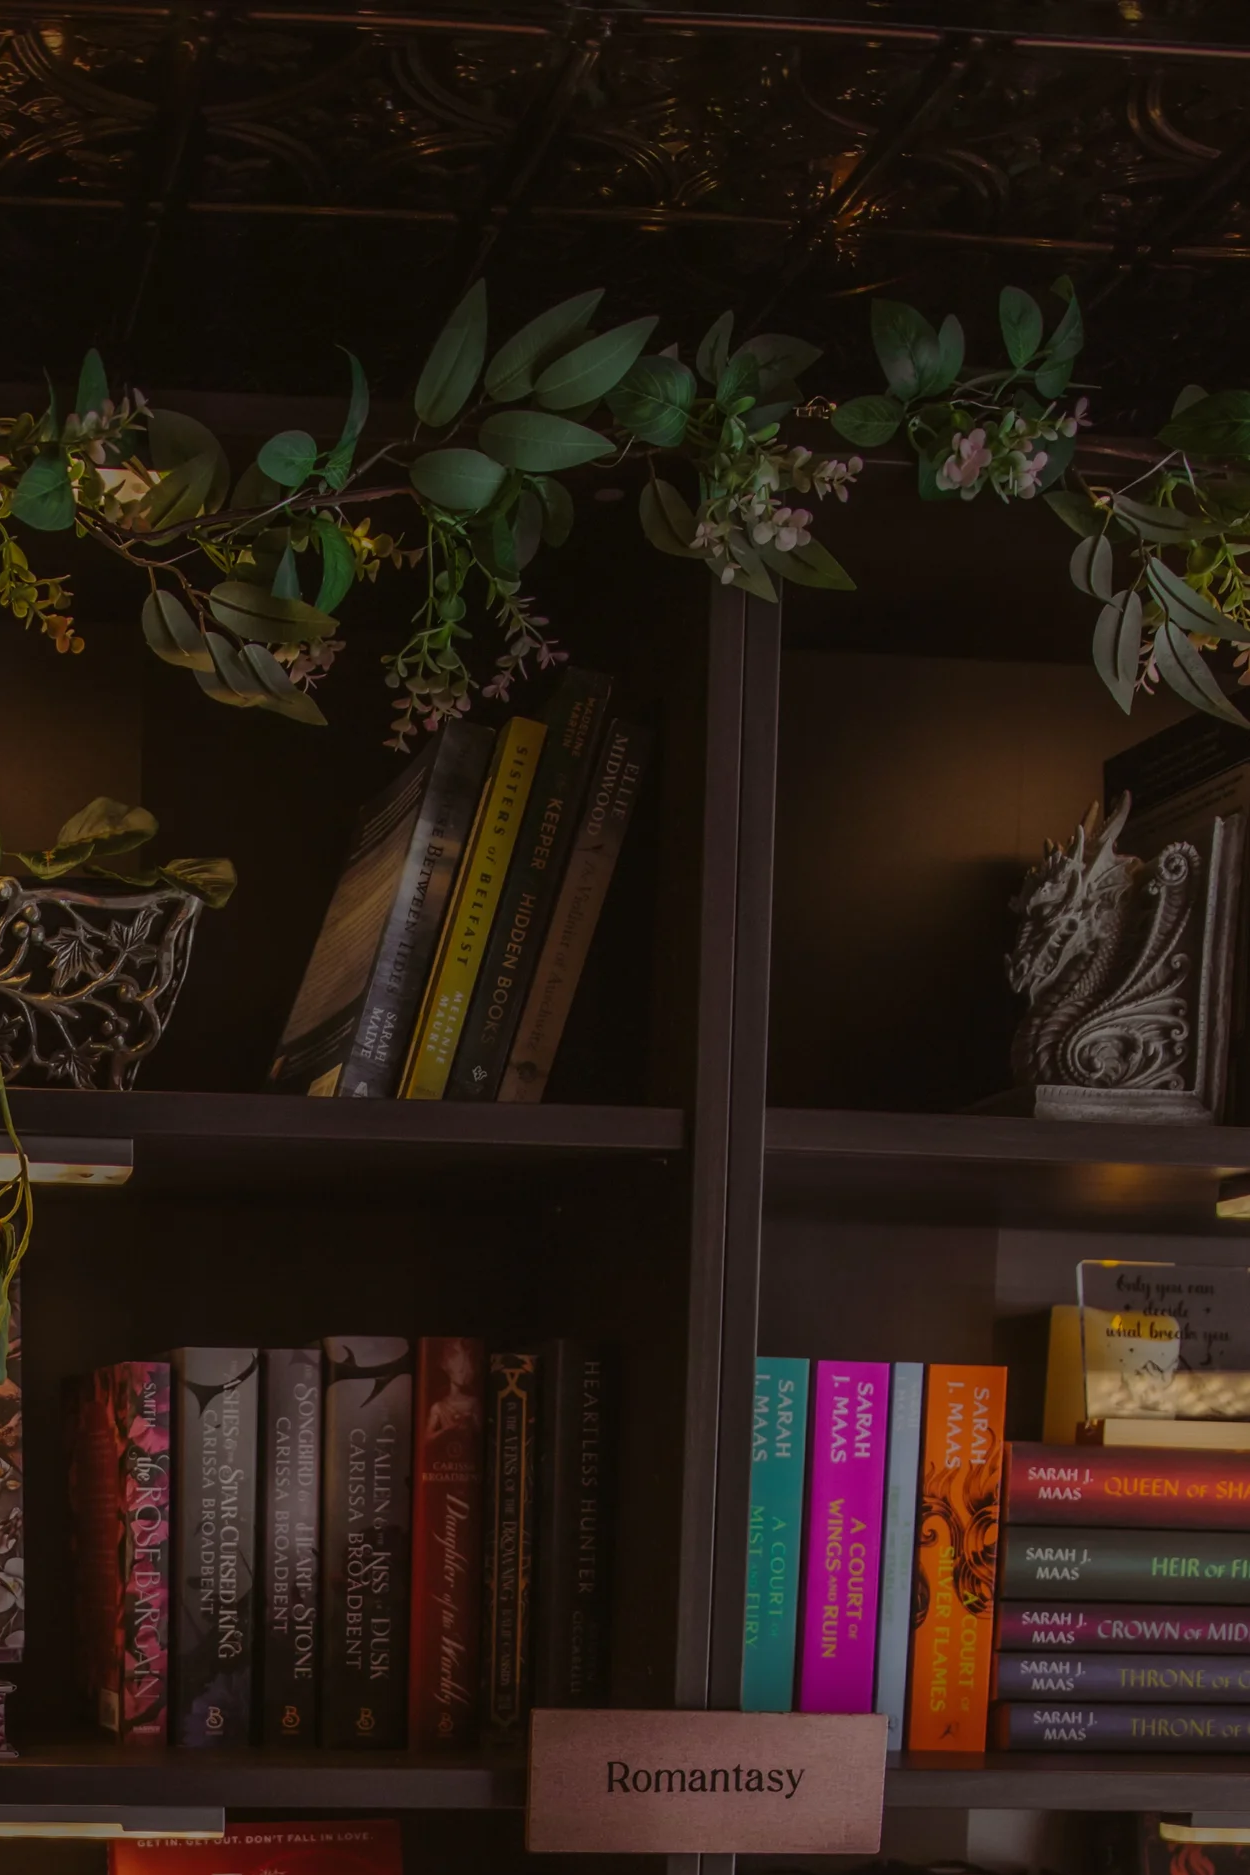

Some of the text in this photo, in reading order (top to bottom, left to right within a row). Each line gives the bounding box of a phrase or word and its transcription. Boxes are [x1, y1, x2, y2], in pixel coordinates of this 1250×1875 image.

[457, 746, 528, 967] SISTERS BELFAST
[481, 892, 536, 1044] HIDDEN BOOKS
[581, 1361, 600, 1488] HEARTLESS
[831, 1376, 851, 1463] J. MAAS
[854, 1382, 874, 1458] SARAH
[274, 1416, 291, 1634] CARISSA BROADBENT
[1104, 1478, 1207, 1498] QUEEN OF
[577, 1499, 594, 1595] HUNTER
[822, 1498, 845, 1657] WINGS AND RUIN
[847, 1518, 866, 1621] A COURT
[1152, 1558, 1226, 1578] HEIR OF
[930, 1546, 955, 1712] SILVER FLAMES
[1097, 1621, 1202, 1641] CROWN OF
[607, 1761, 805, 1799] Romantasy
[245, 1834, 283, 1845] DON'T
[287, 1833, 316, 1844] FALL
[320, 1832, 334, 1842] IN
